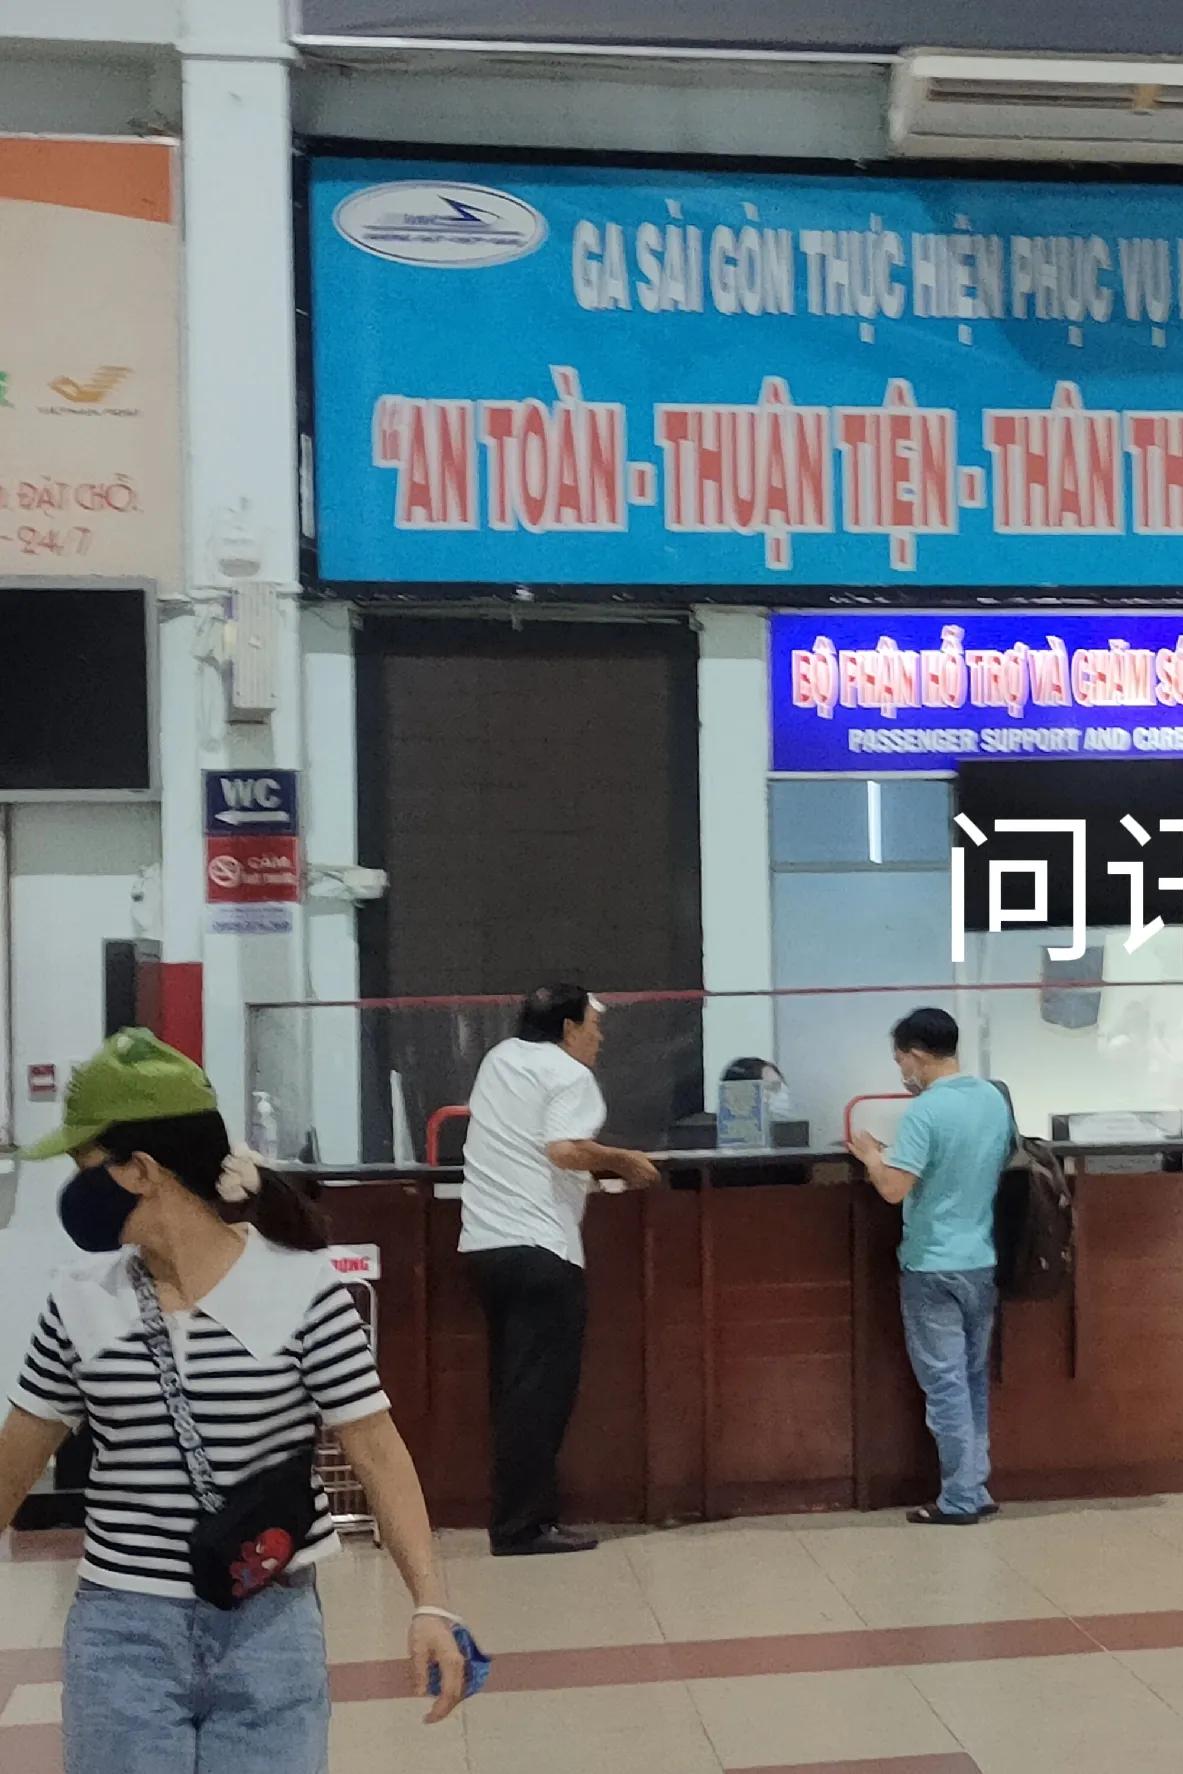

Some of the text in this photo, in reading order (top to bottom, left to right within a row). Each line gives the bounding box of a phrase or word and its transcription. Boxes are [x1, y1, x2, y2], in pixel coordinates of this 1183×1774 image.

[572, 219, 632, 312] GA
[635, 199, 704, 313] SÀI
[709, 202, 796, 316] GÒN
[800, 212, 907, 344] THỰC
[911, 213, 1003, 345] HIỆN
[1010, 234, 1114, 347] PHỤC
[1118, 237, 1171, 347] VỤ
[479, 364, 629, 532] TOÀN
[654, 375, 836, 570] THUẬN
[831, 377, 958, 571] TIỆN
[982, 379, 1126, 534] THÂN
[792, 635, 839, 719] BỘ
[839, 635, 921, 719] PHẬN
[1027, 635, 1072, 707] VÀ
[1071, 638, 1157, 707] CHĂM
[848, 728, 981, 753] PASSENGER
[980, 728, 1082, 753] SUPPORT
[1083, 727, 1132, 751] AND
[220, 777, 281, 808] WC
